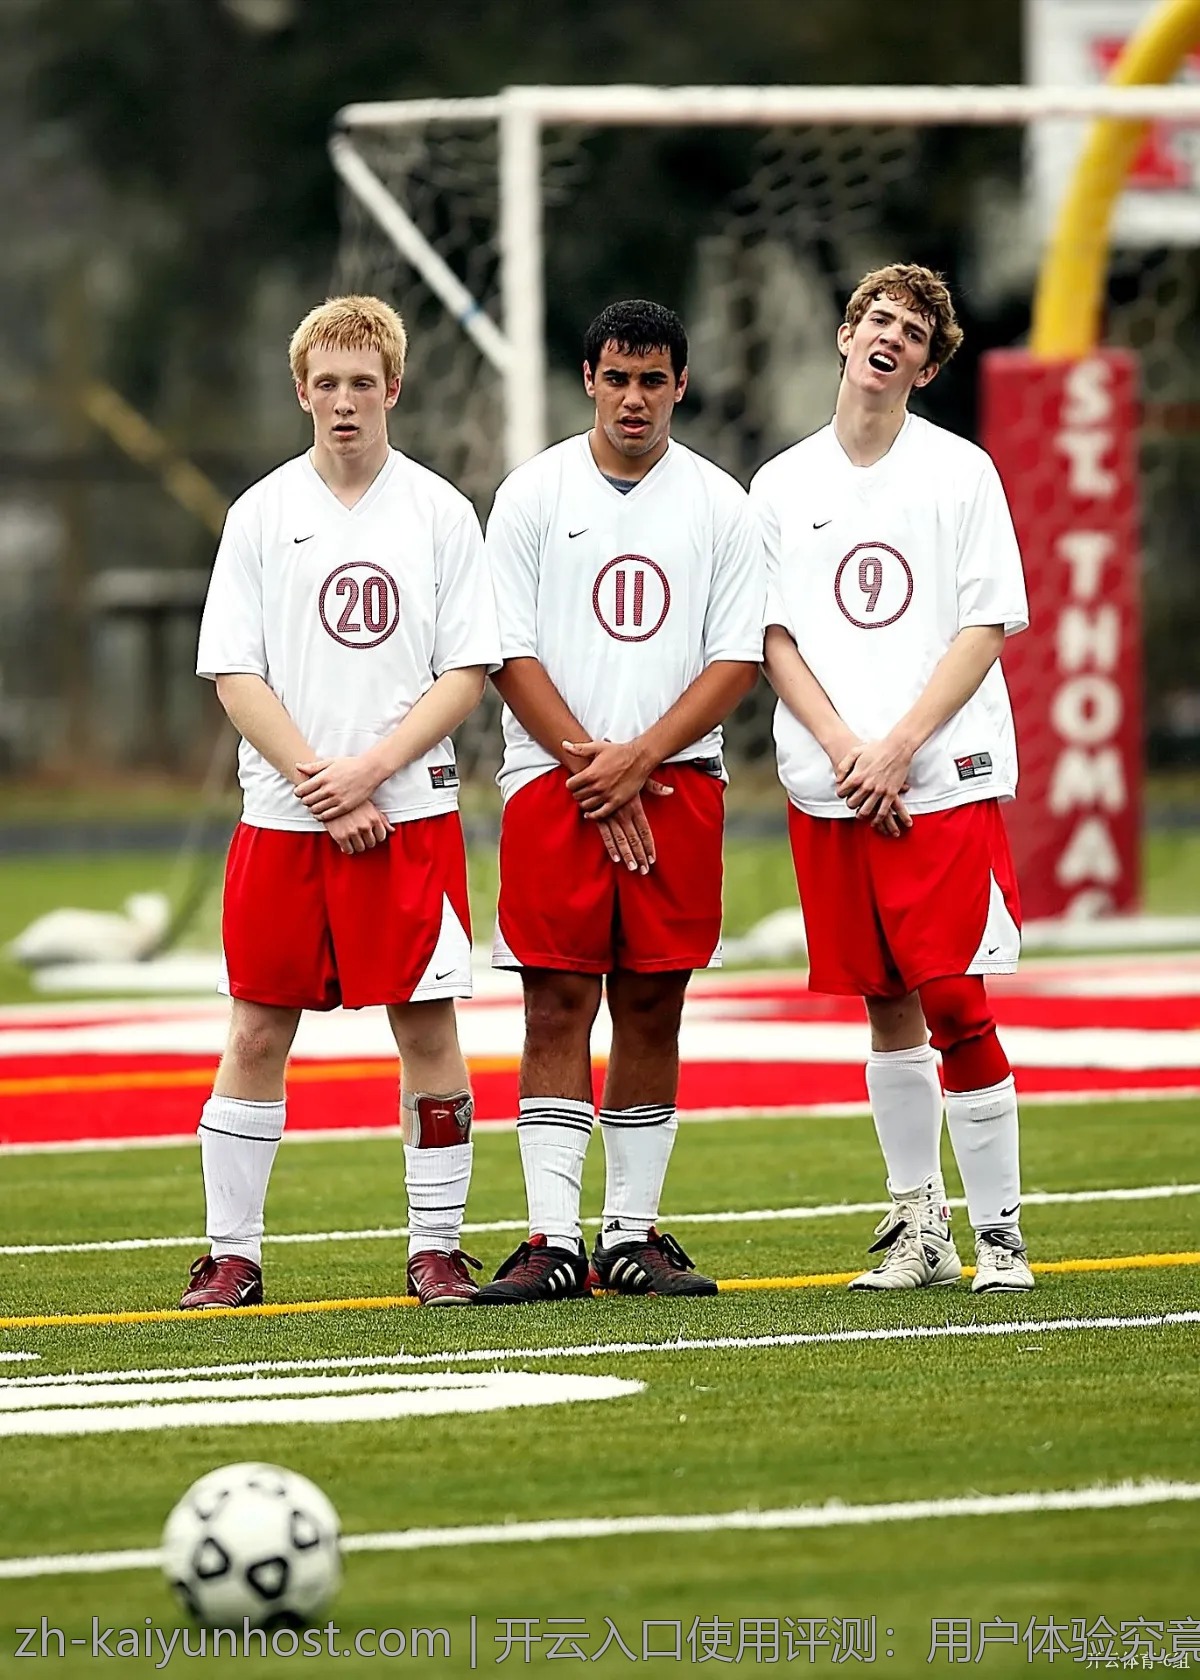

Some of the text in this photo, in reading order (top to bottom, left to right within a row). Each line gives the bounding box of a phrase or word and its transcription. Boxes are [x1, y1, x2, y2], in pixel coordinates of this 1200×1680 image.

[336, 576, 388, 633] 20
[616, 570, 644, 626] 11
[859, 556, 882, 612] 9
